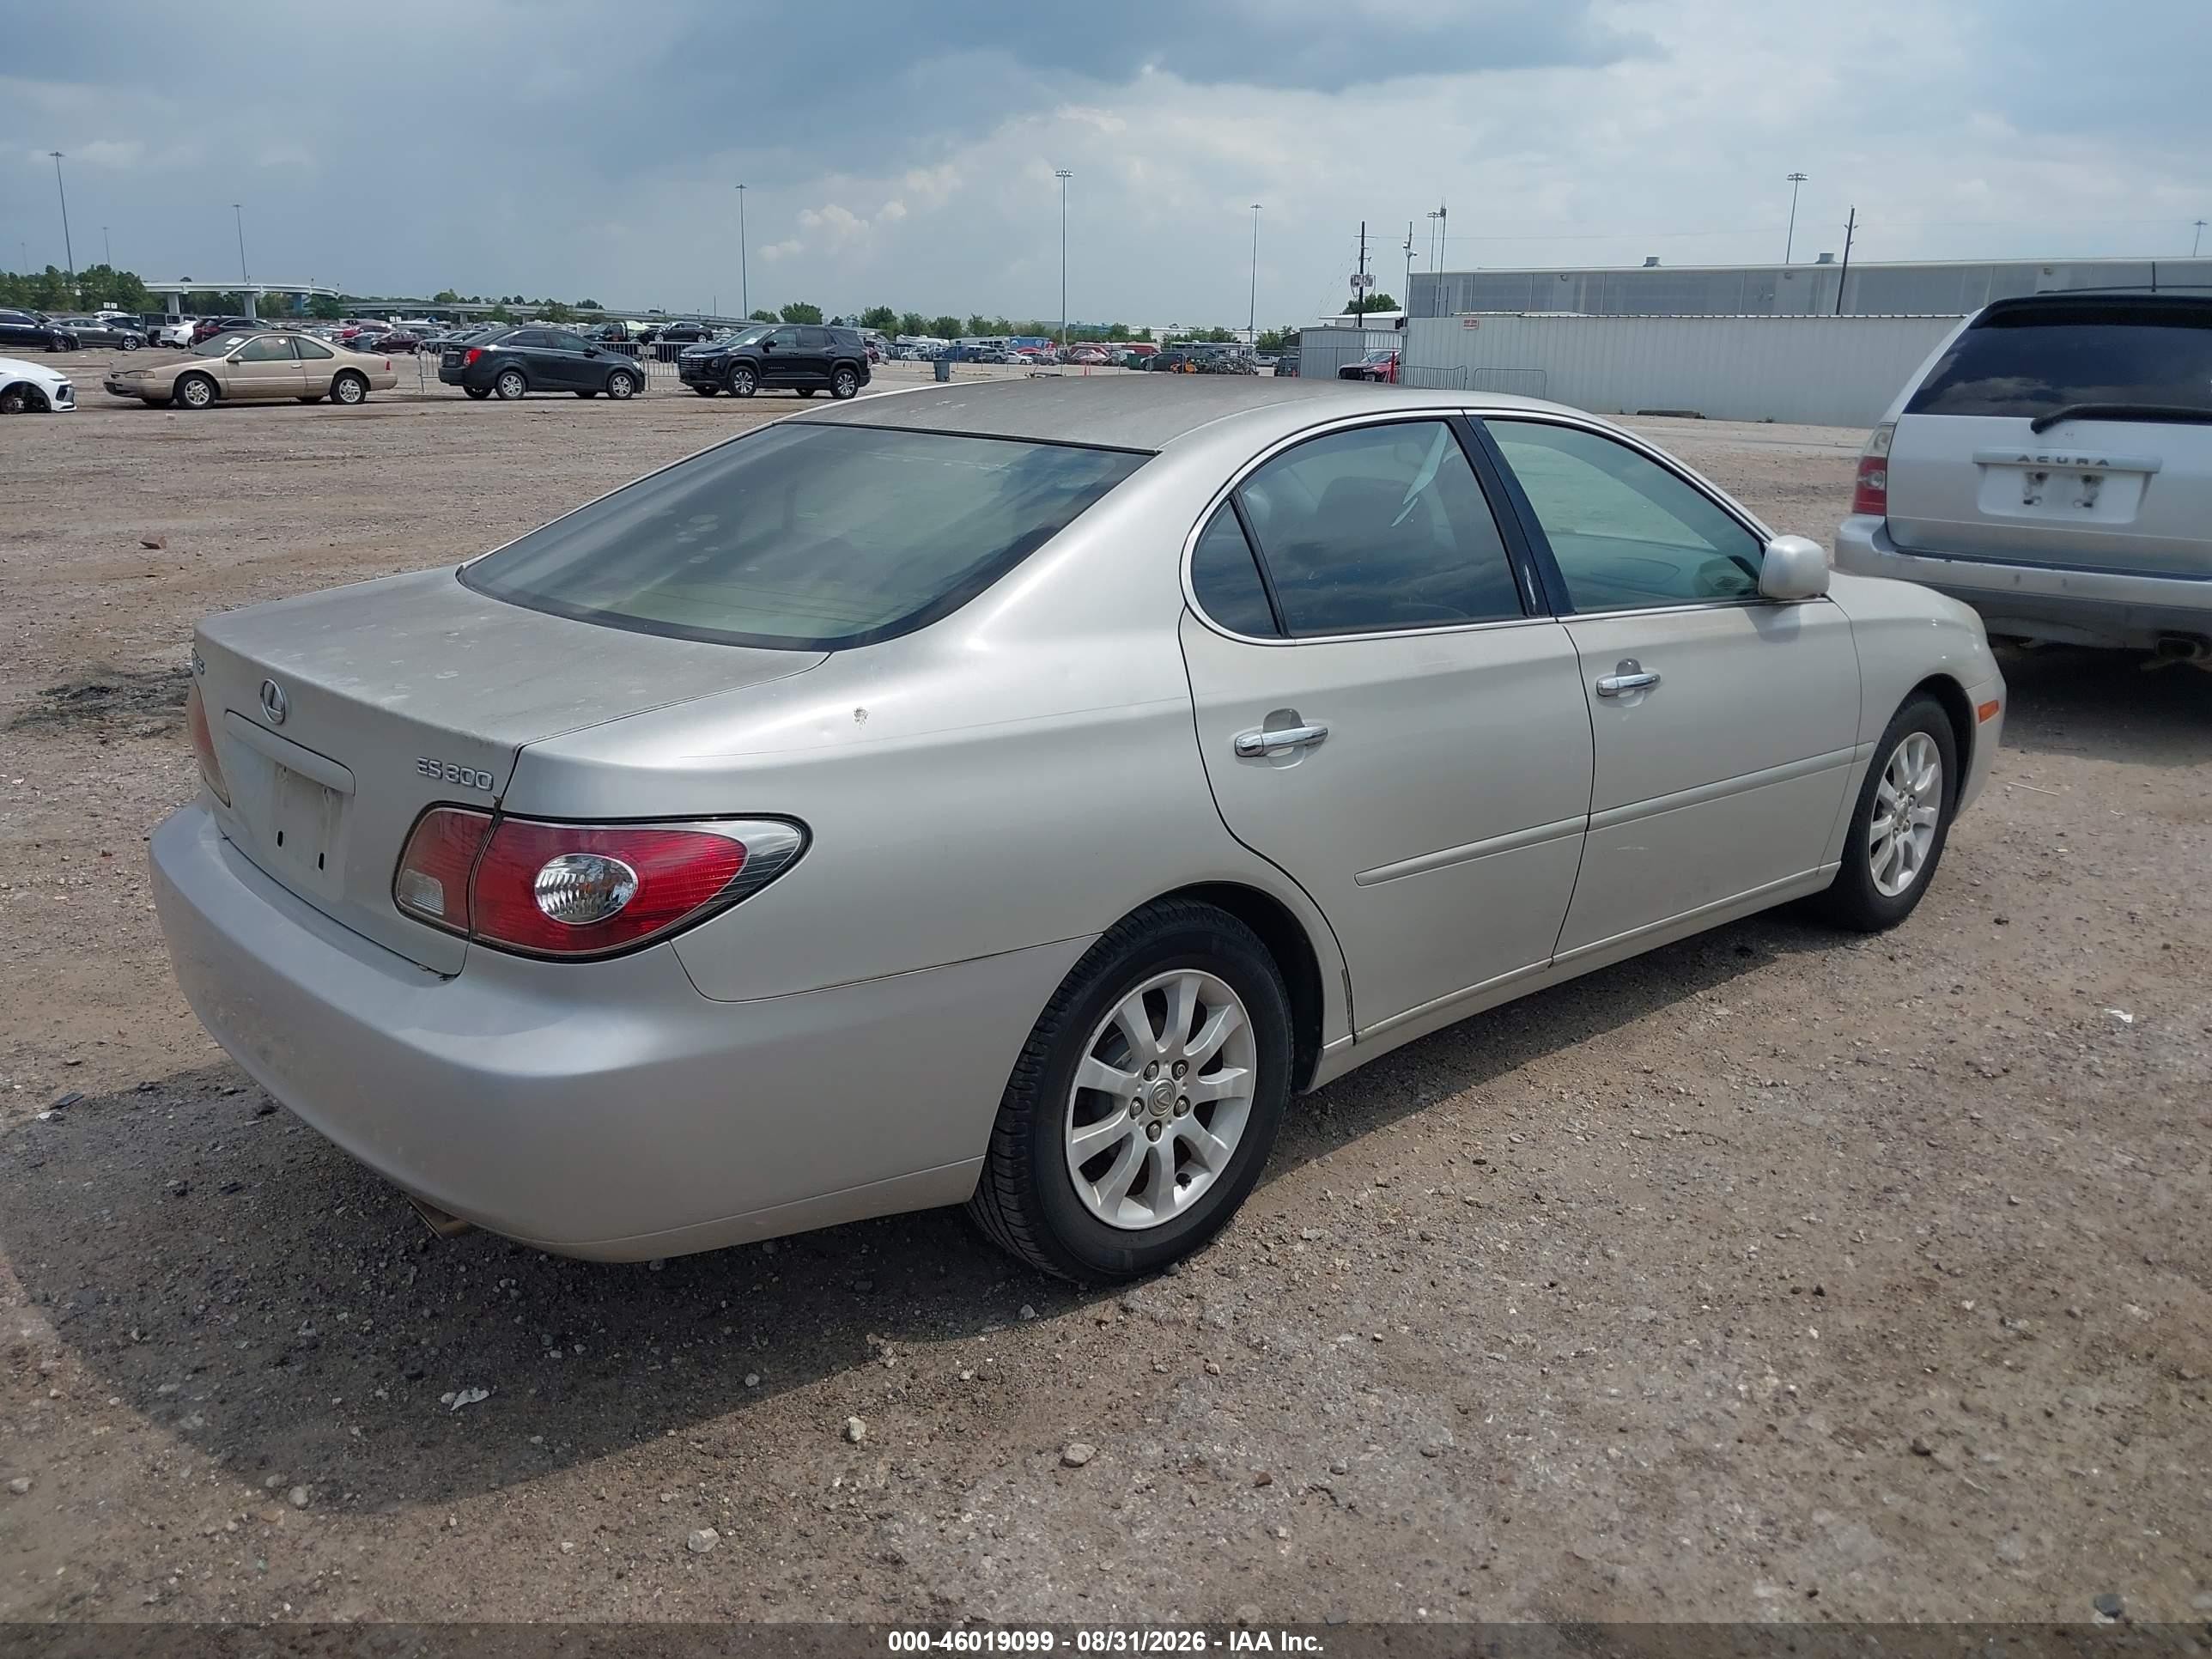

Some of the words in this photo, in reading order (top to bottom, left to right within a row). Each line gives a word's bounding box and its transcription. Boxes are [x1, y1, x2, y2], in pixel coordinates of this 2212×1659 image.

[2016, 454, 2110, 466] ACURA
[416, 757, 442, 779] ES
[446, 763, 493, 791] 300
